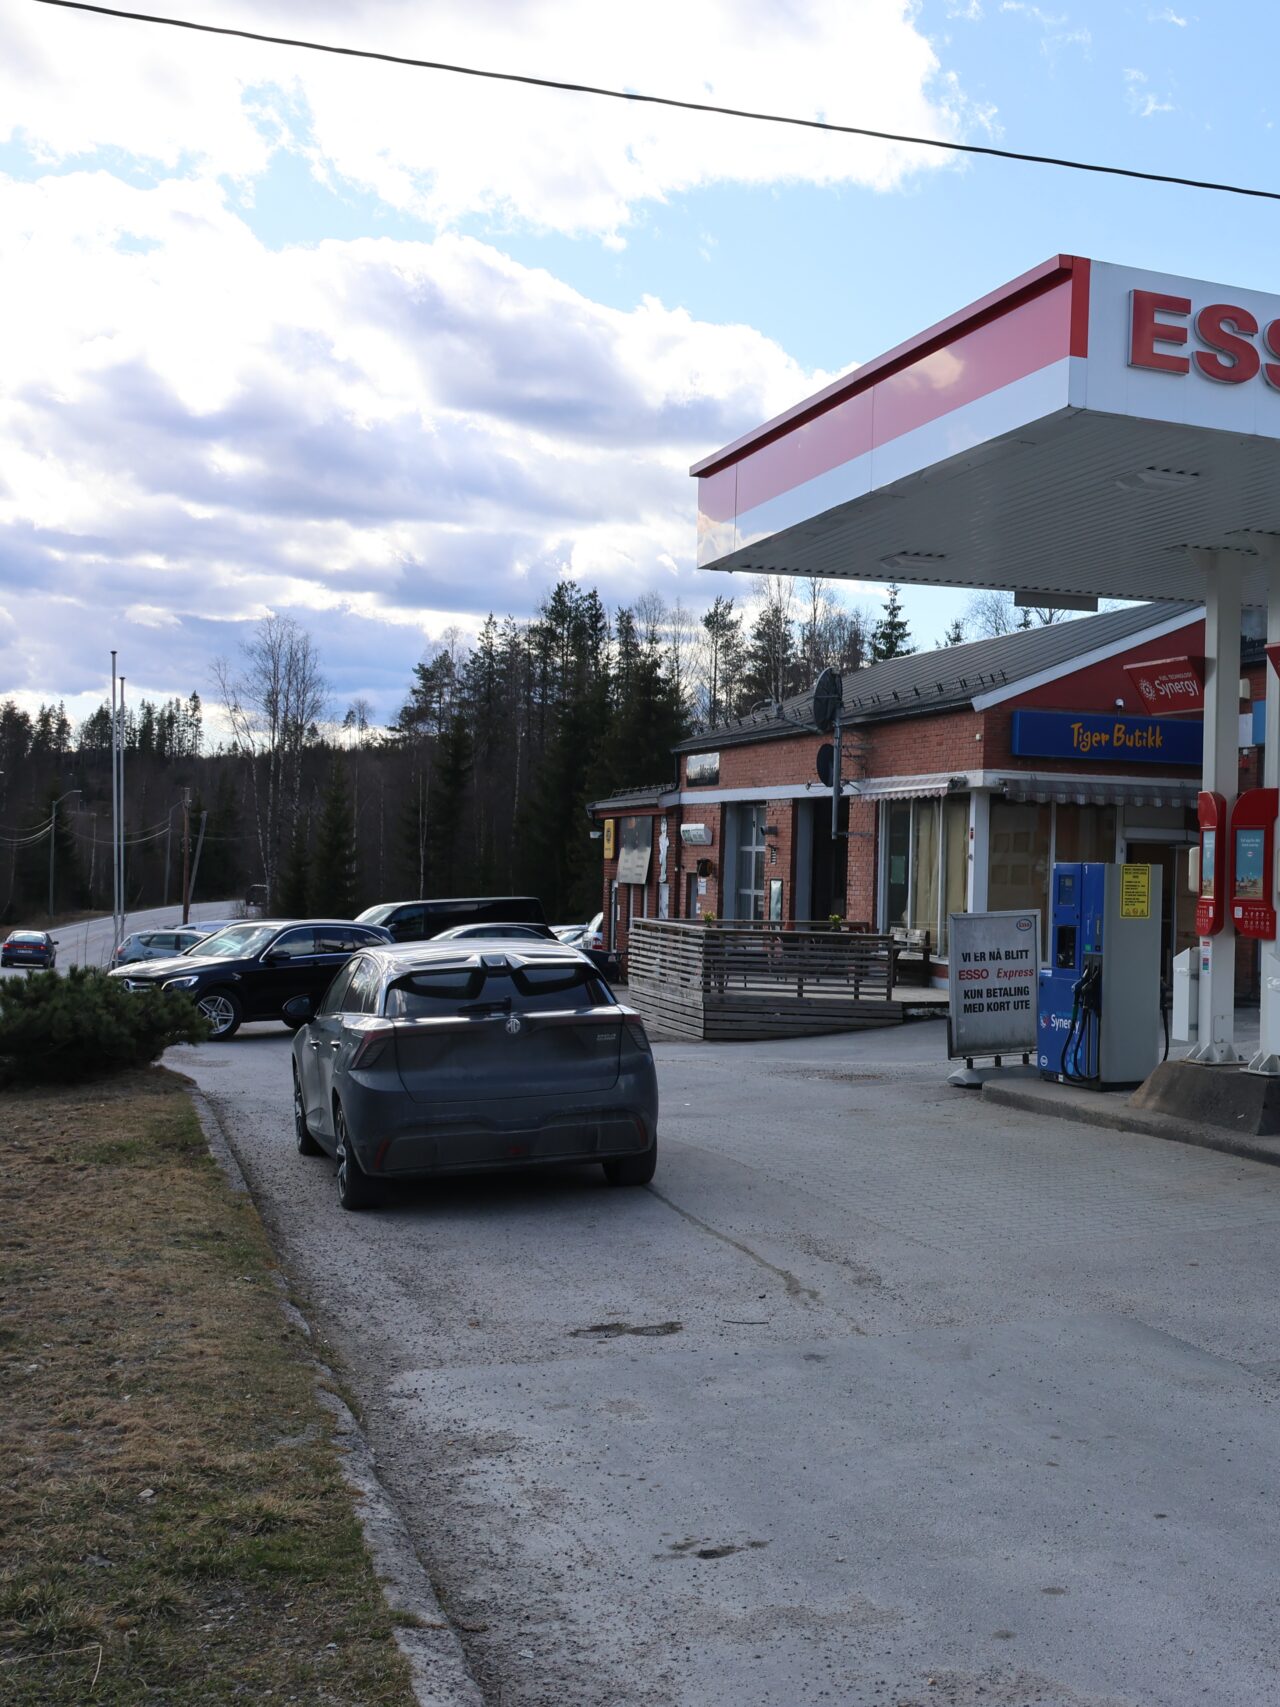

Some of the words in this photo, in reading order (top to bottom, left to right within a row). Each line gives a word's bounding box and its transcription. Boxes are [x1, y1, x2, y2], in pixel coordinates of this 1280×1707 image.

[1154, 680, 1199, 699] Synergy
[1070, 722, 1110, 752] Tiger
[1112, 723, 1163, 749] Butikk
[961, 952, 971, 962] VI
[974, 952, 986, 962] ER
[989, 948, 1002, 961] NÅ
[1004, 950, 1030, 960] BLITT
[958, 969, 989, 980] ESSO
[996, 968, 1034, 981] Express
[964, 989, 983, 1000] KUN
[986, 986, 1030, 998] BETALING
[963, 1002, 984, 1014] MED
[986, 1001, 1010, 1012] KORT
[1013, 1000, 1030, 1010] UTE
[1050, 1013, 1080, 1034] Synery
